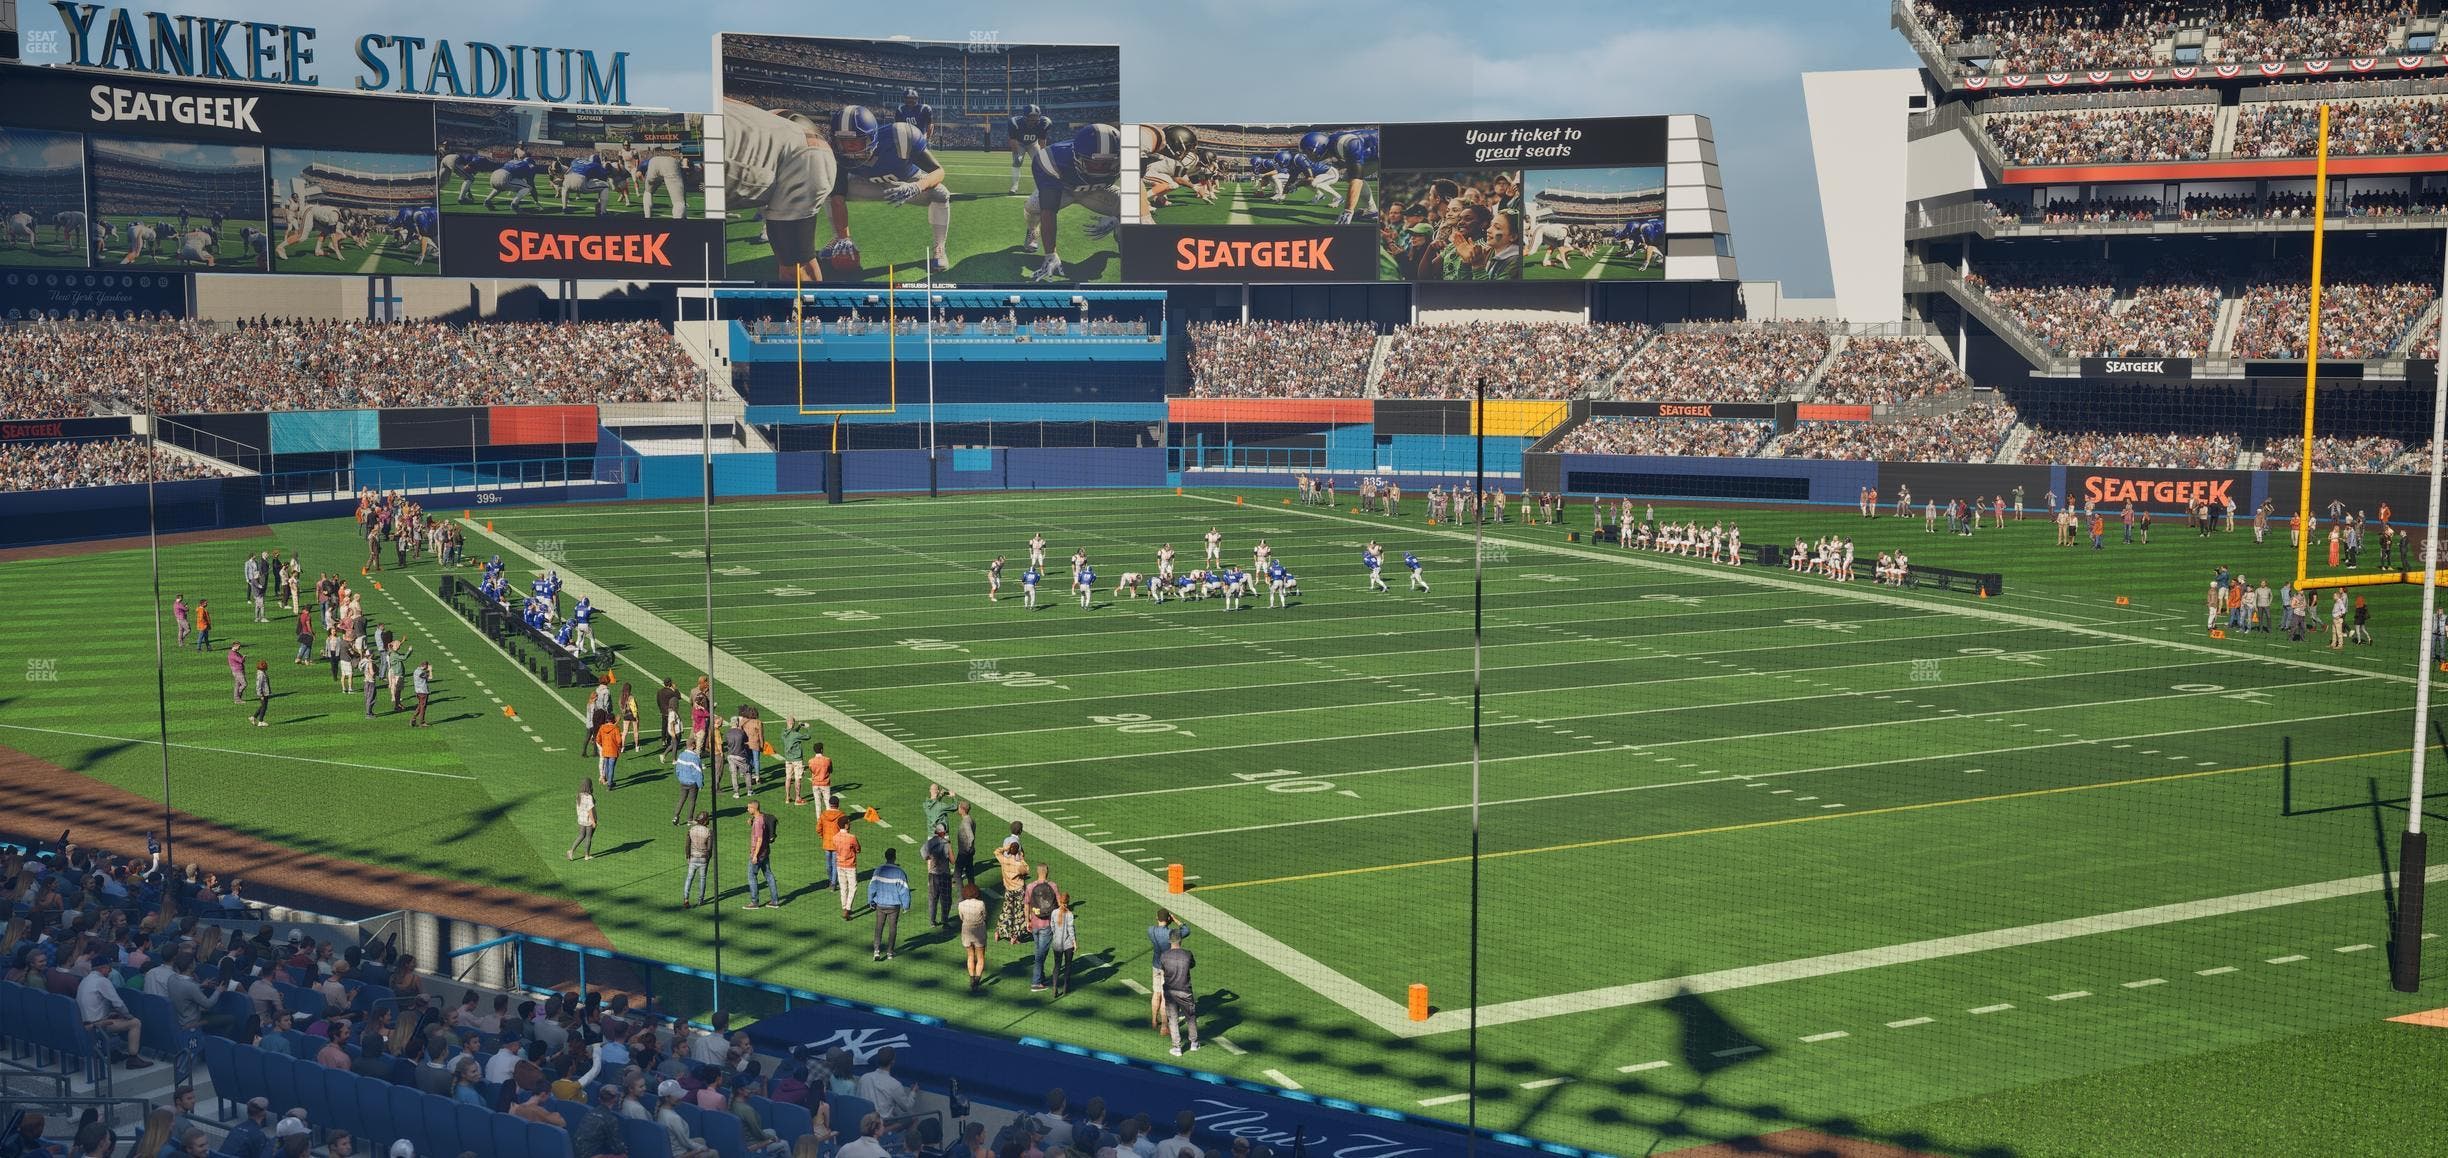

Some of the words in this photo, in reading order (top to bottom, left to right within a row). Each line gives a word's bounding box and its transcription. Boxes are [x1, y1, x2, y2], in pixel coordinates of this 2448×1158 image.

[48, 0, 319, 87] YANKEE
[354, 33, 631, 107] STADIUM
[90, 84, 262, 133] SEATGEEK
[1465, 129, 1508, 145] Your
[1511, 128, 1562, 142] ticket
[1565, 127, 1582, 140] to
[1475, 145, 1523, 162] great
[1525, 143, 1572, 158] seats
[498, 229, 673, 267] SEATGEEK
[1176, 237, 1335, 272] SEATGEEK
[2105, 360, 2164, 374] SEATGEEK
[1660, 404, 1713, 417] SEATGEEK
[2, 422, 63, 440] SEATGEEK
[2085, 475, 2235, 508] SEATGEEK
[1087, 713, 1178, 733] 20
[1230, 769, 1336, 793] 10
[1192, 1099, 1328, 1147] New
